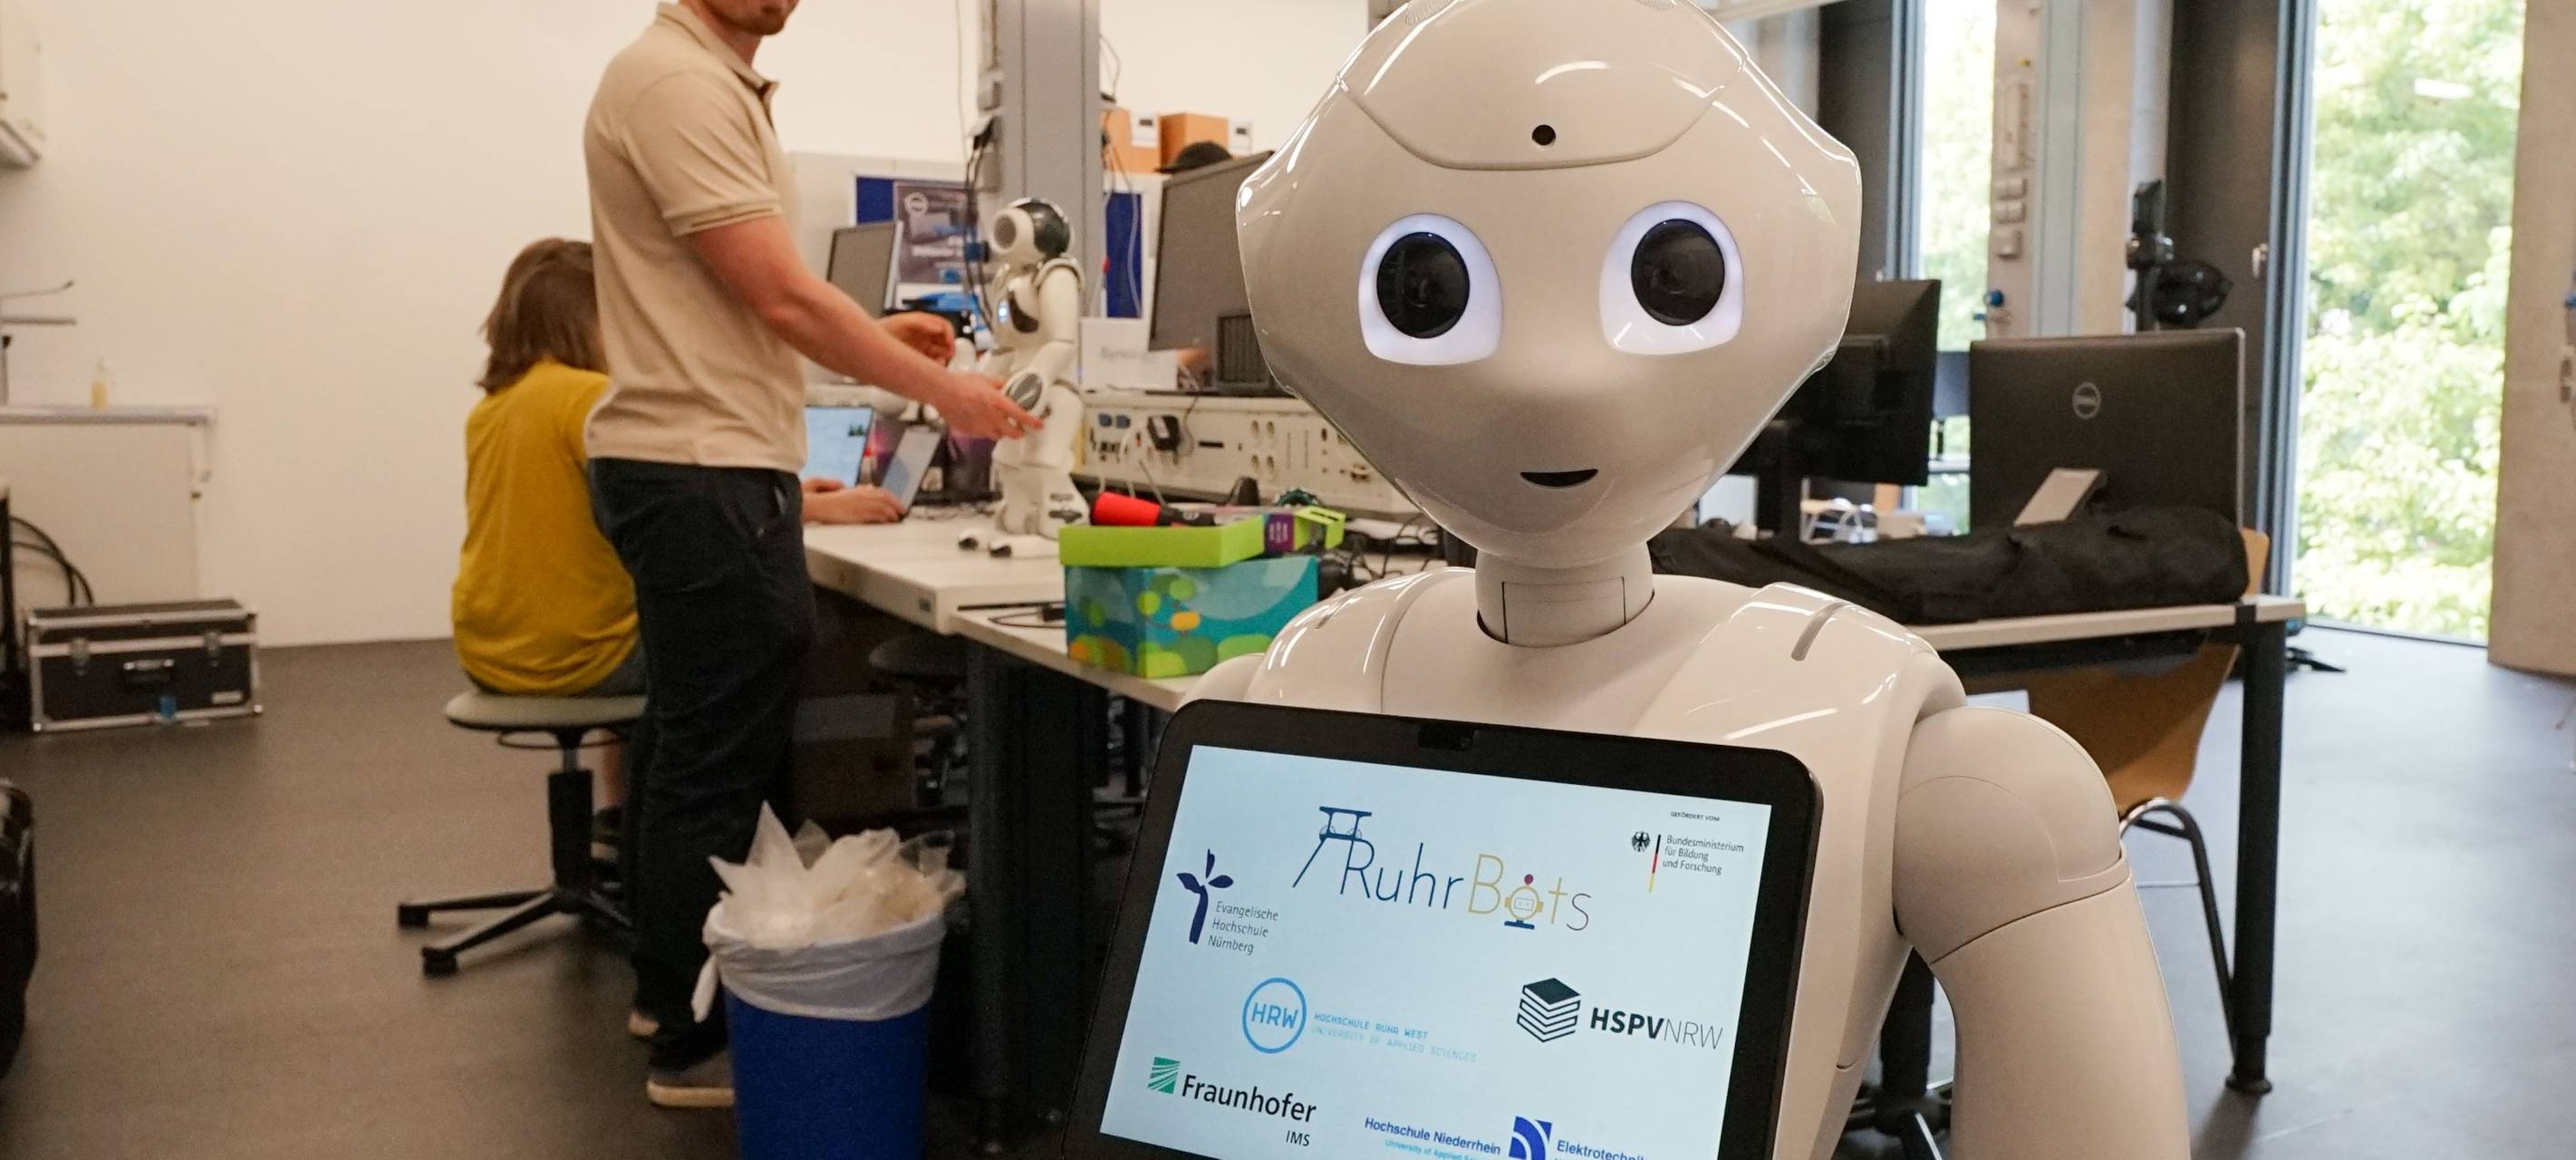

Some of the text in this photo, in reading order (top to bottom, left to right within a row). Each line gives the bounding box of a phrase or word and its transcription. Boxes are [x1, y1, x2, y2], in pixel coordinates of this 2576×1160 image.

[1666, 835, 1744, 852] Bundesministerium
[1664, 846, 1709, 862] für Bildung
[1663, 859, 1722, 875] und Forschung
[1216, 901, 1278, 921] Evangelische
[1212, 918, 1269, 938] Hochschule
[1208, 935, 1254, 955] Nürnberg
[1251, 1002, 1298, 1030] HRW
[1315, 1012, 1428, 1040] HOCHSCHULE RUHR WEST
[1182, 1074, 1317, 1123] Fraunhofer
[1286, 1130, 1310, 1146] IMS
[1365, 1116, 1500, 1155] Hochschule Niederrhein
[1384, 1139, 1422, 1155] University
[1423, 1147, 1432, 1155] of
